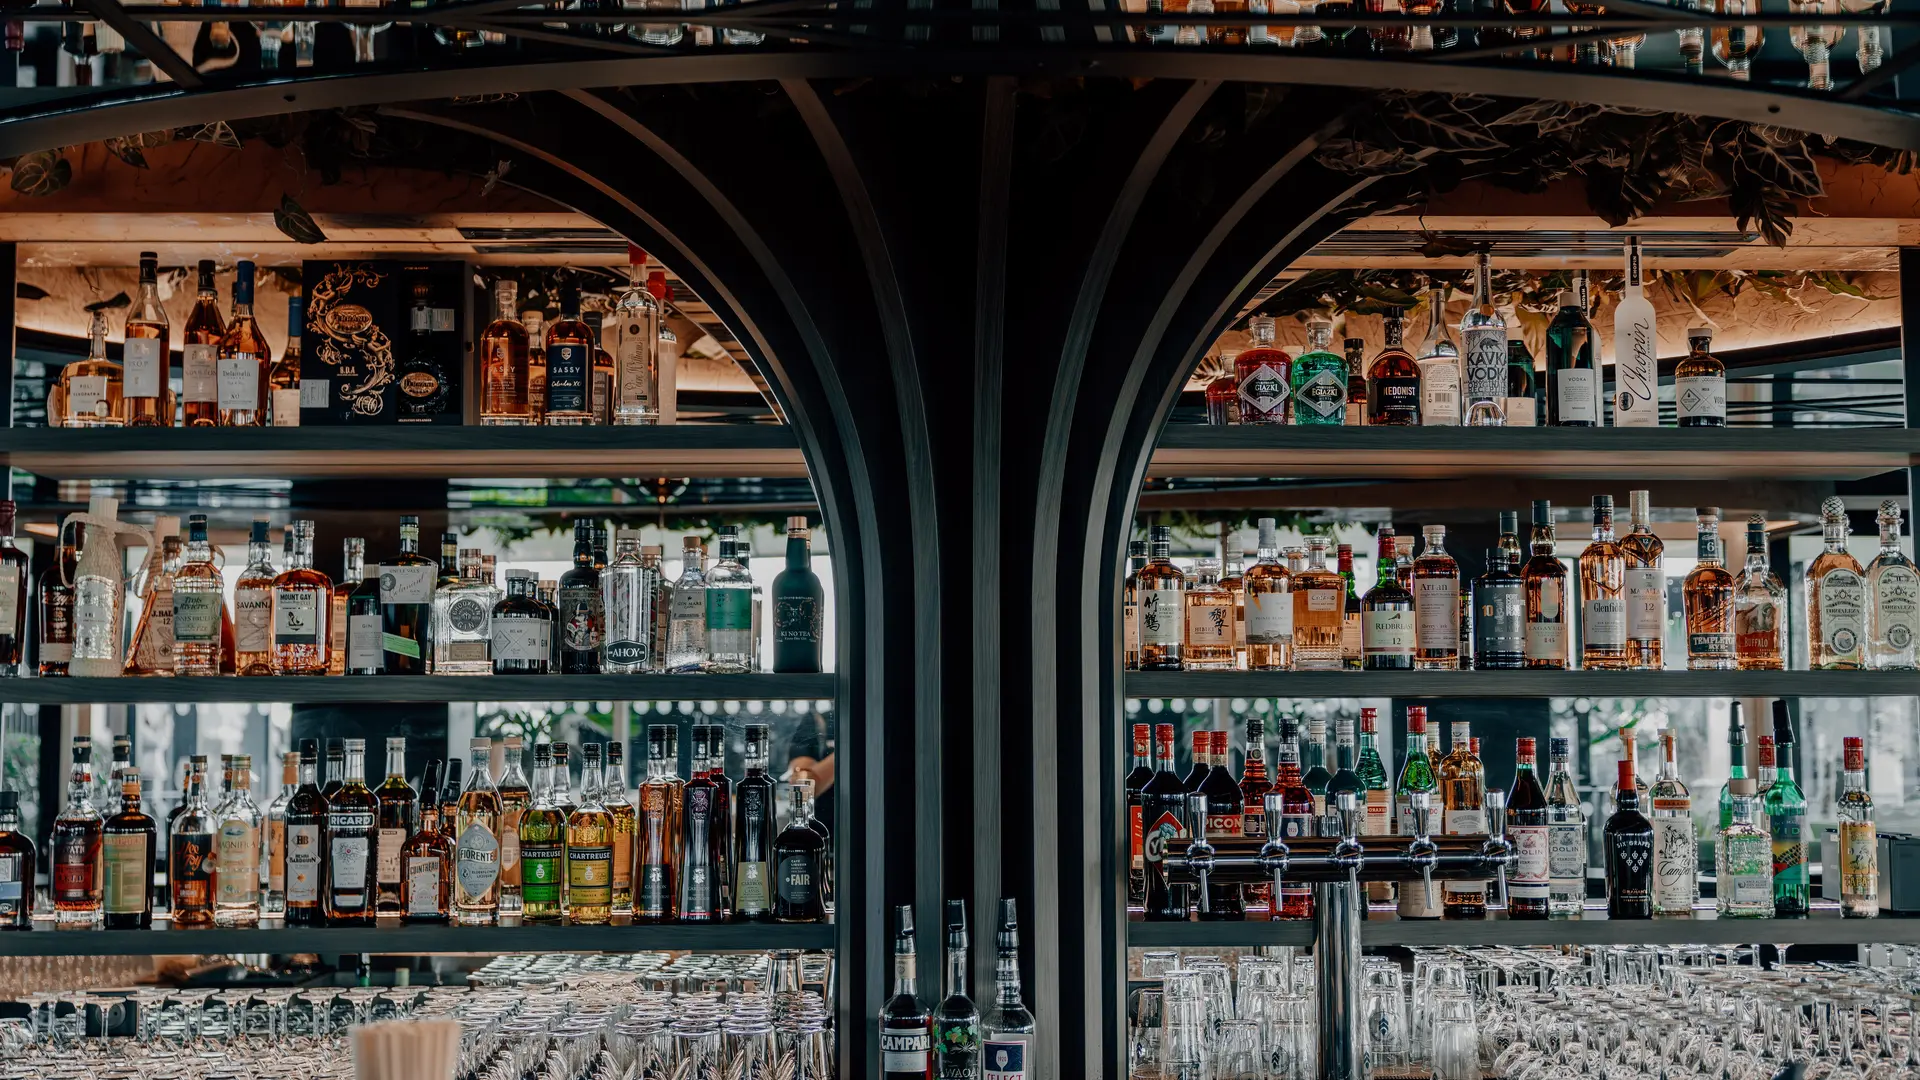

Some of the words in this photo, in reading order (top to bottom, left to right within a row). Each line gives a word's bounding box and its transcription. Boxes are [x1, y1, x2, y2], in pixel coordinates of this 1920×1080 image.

[1622, 317, 1655, 401] Chopin
[552, 366, 581, 374] SASSY
[1706, 541, 1715, 552] 6
[1420, 583, 1448, 591] Arran
[280, 593, 299, 601] MOUNT
[300, 593, 312, 601] GAY
[452, 600, 481, 616] BROOKLYN
[1481, 604, 1494, 617] 10
[1644, 602, 1655, 611] 12
[457, 622, 475, 630] GIN
[527, 638, 536, 646] GIN
[1392, 637, 1401, 645] 12
[1744, 638, 1769, 647] BUFFALO
[612, 647, 641, 658] AHOY
[330, 816, 369, 825] RICARD
[296, 835, 309, 845] HB
[460, 849, 494, 862] FIORENTE
[569, 852, 610, 860] CHARTREUSE
[409, 860, 439, 875] COINTREAU
[790, 874, 811, 886] FAIR
[880, 1035, 930, 1051] CAMPARI
